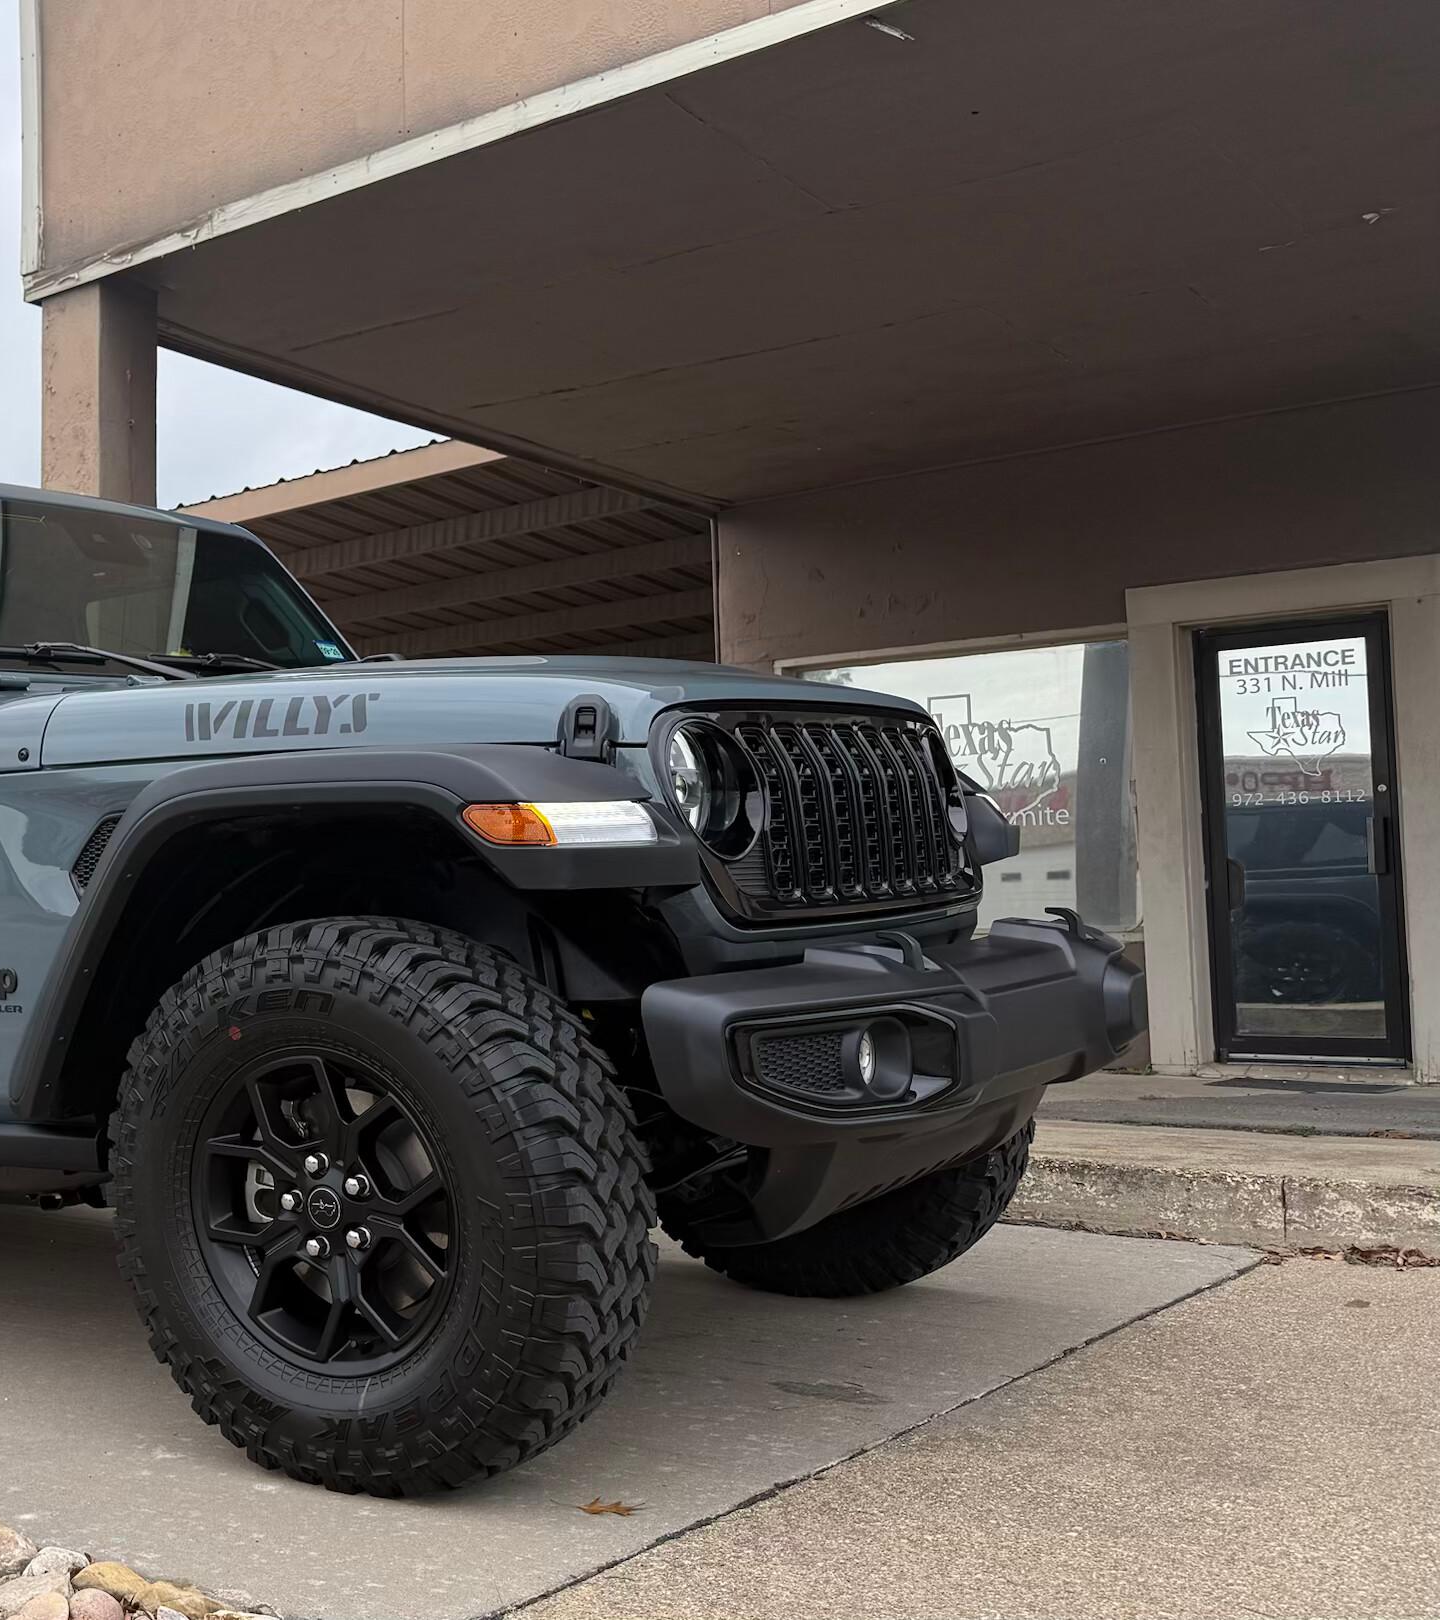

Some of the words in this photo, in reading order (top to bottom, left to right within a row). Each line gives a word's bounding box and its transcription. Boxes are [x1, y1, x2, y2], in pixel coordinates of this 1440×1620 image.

[1228, 648, 1356, 676] ENTRANCE
[1236, 677, 1272, 695] 331
[1281, 674, 1304, 692] N.
[1310, 669, 1349, 689] Mill
[185, 693, 381, 742] WILLYS
[1266, 706, 1321, 731] Texas
[931, 713, 1013, 761] exas
[1292, 724, 1345, 746] Star
[1003, 803, 1070, 827] rmite
